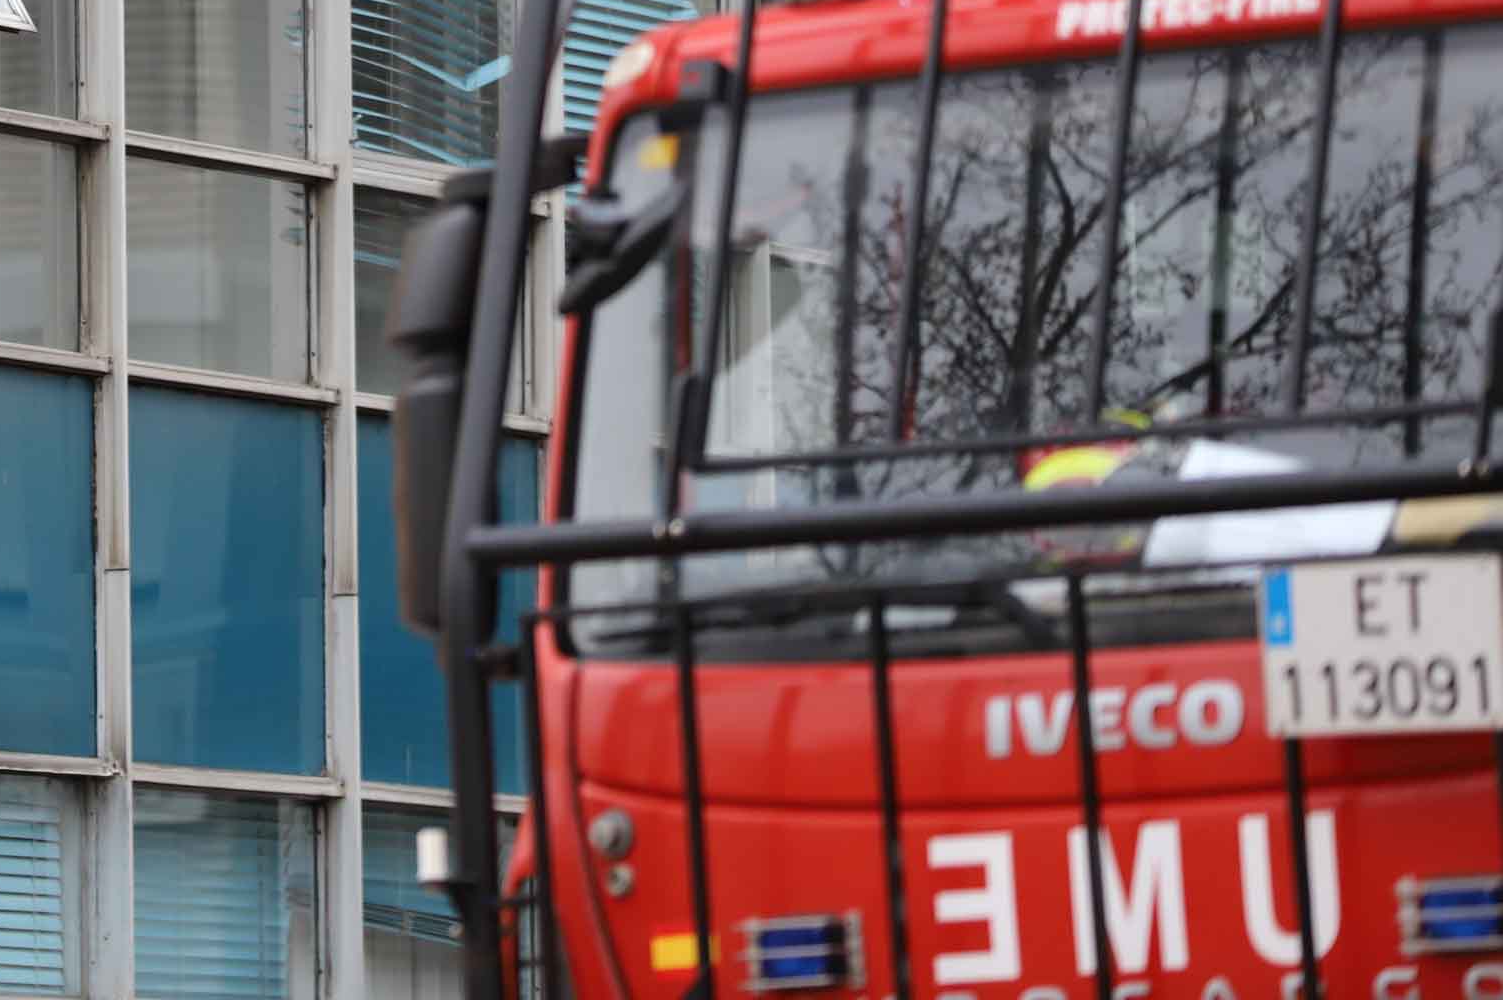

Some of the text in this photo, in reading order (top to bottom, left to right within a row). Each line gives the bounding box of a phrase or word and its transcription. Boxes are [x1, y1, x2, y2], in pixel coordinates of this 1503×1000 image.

[1354, 572, 1427, 637] ET
[984, 678, 1245, 759] IVECO
[1284, 655, 1490, 722] 113091
